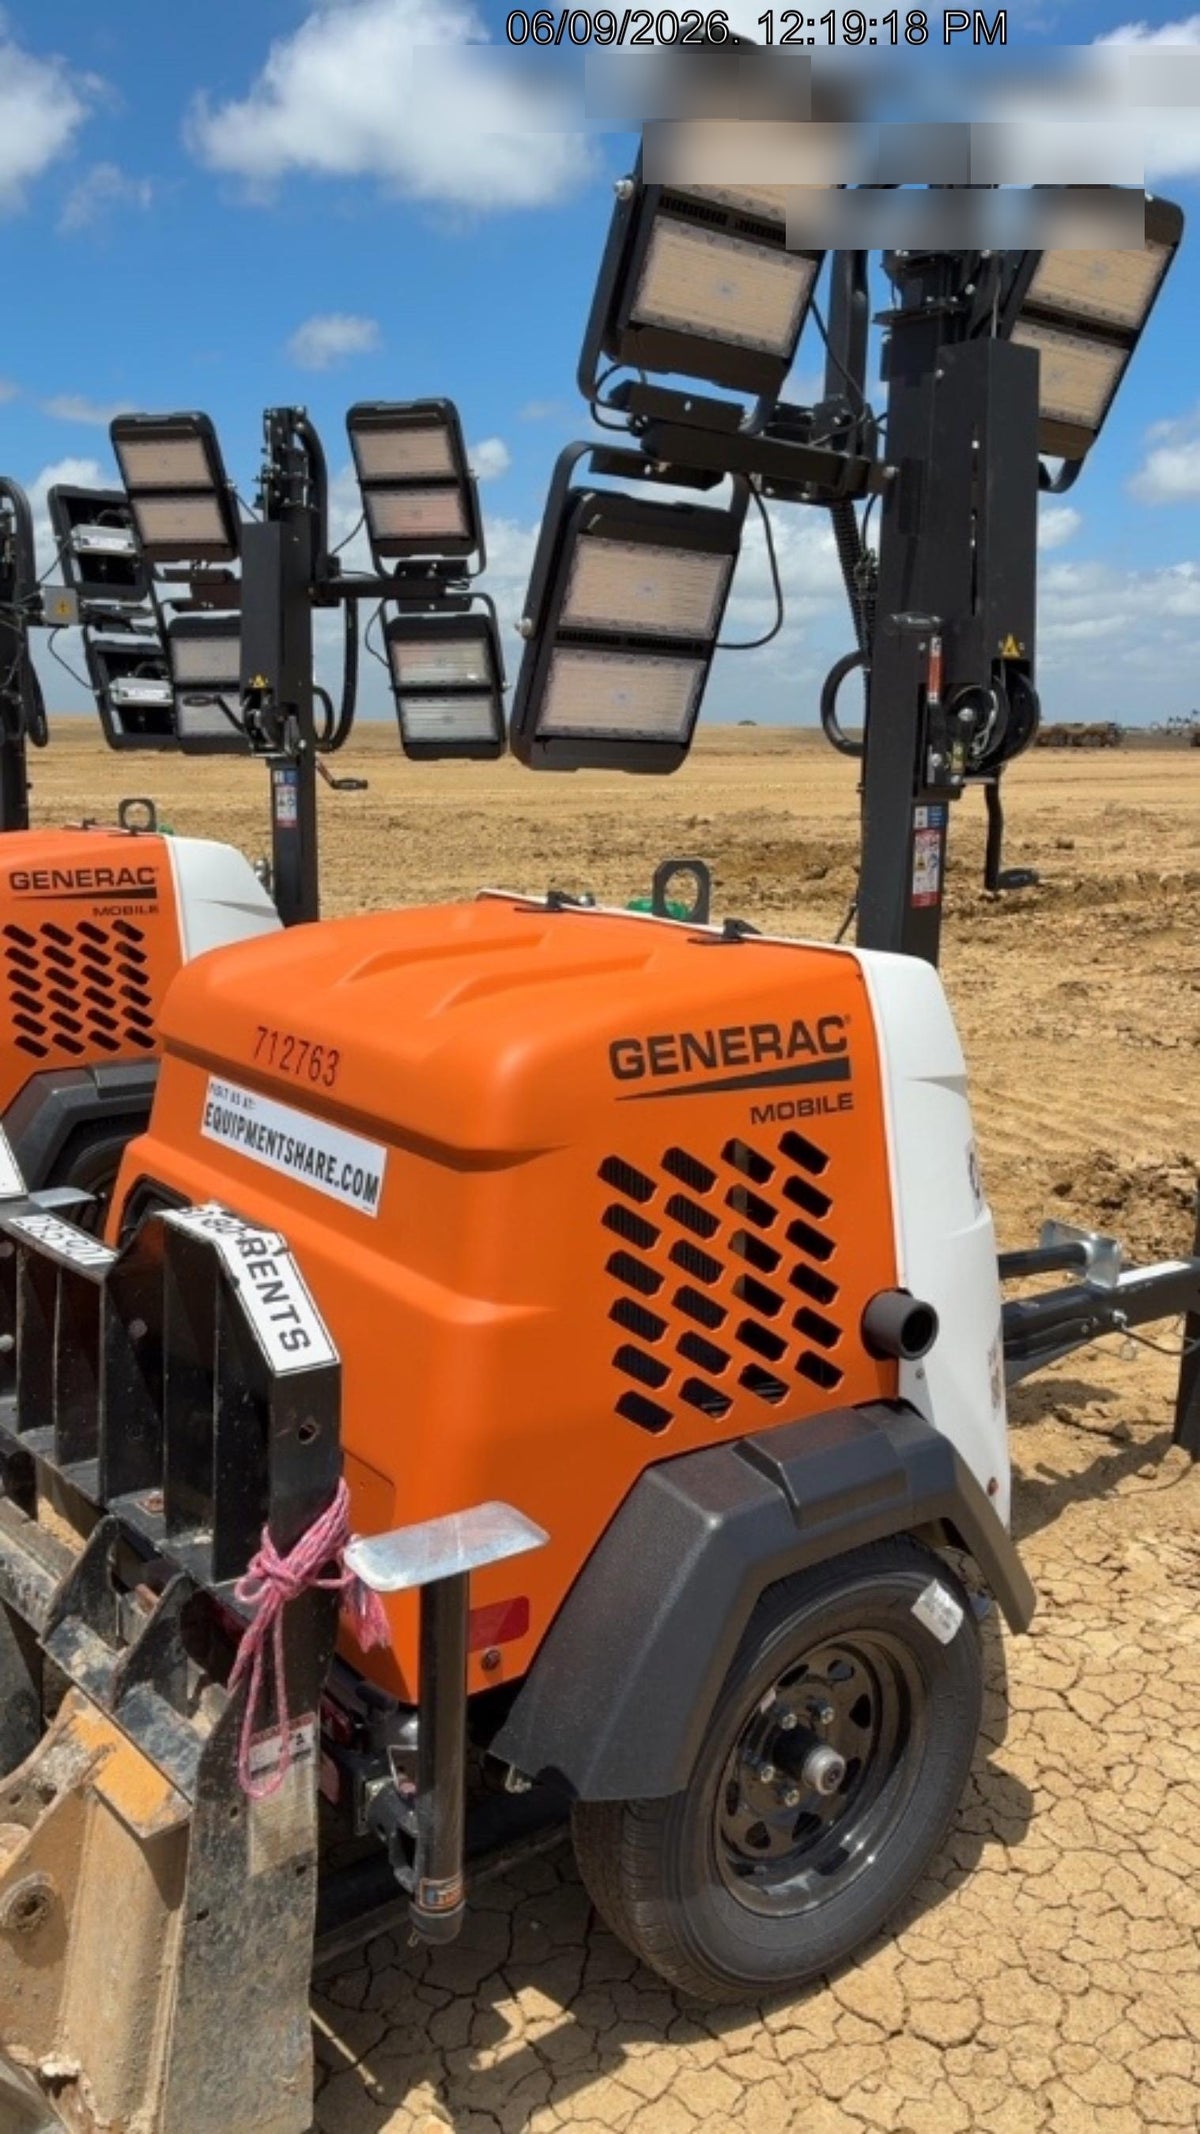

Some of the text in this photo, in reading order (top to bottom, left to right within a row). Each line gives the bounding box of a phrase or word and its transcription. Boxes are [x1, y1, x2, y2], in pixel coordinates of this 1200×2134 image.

[9, 867, 157, 890] GENERAC
[92, 904, 159, 917] MOBILE
[253, 1025, 340, 1087] 712763
[608, 1014, 848, 1081] GENERAC
[750, 1092, 854, 1125] MOBILE
[203, 1102, 380, 1205] EQUIPMENTSHARE.COM
[234, 1236, 312, 1352] RENTS
